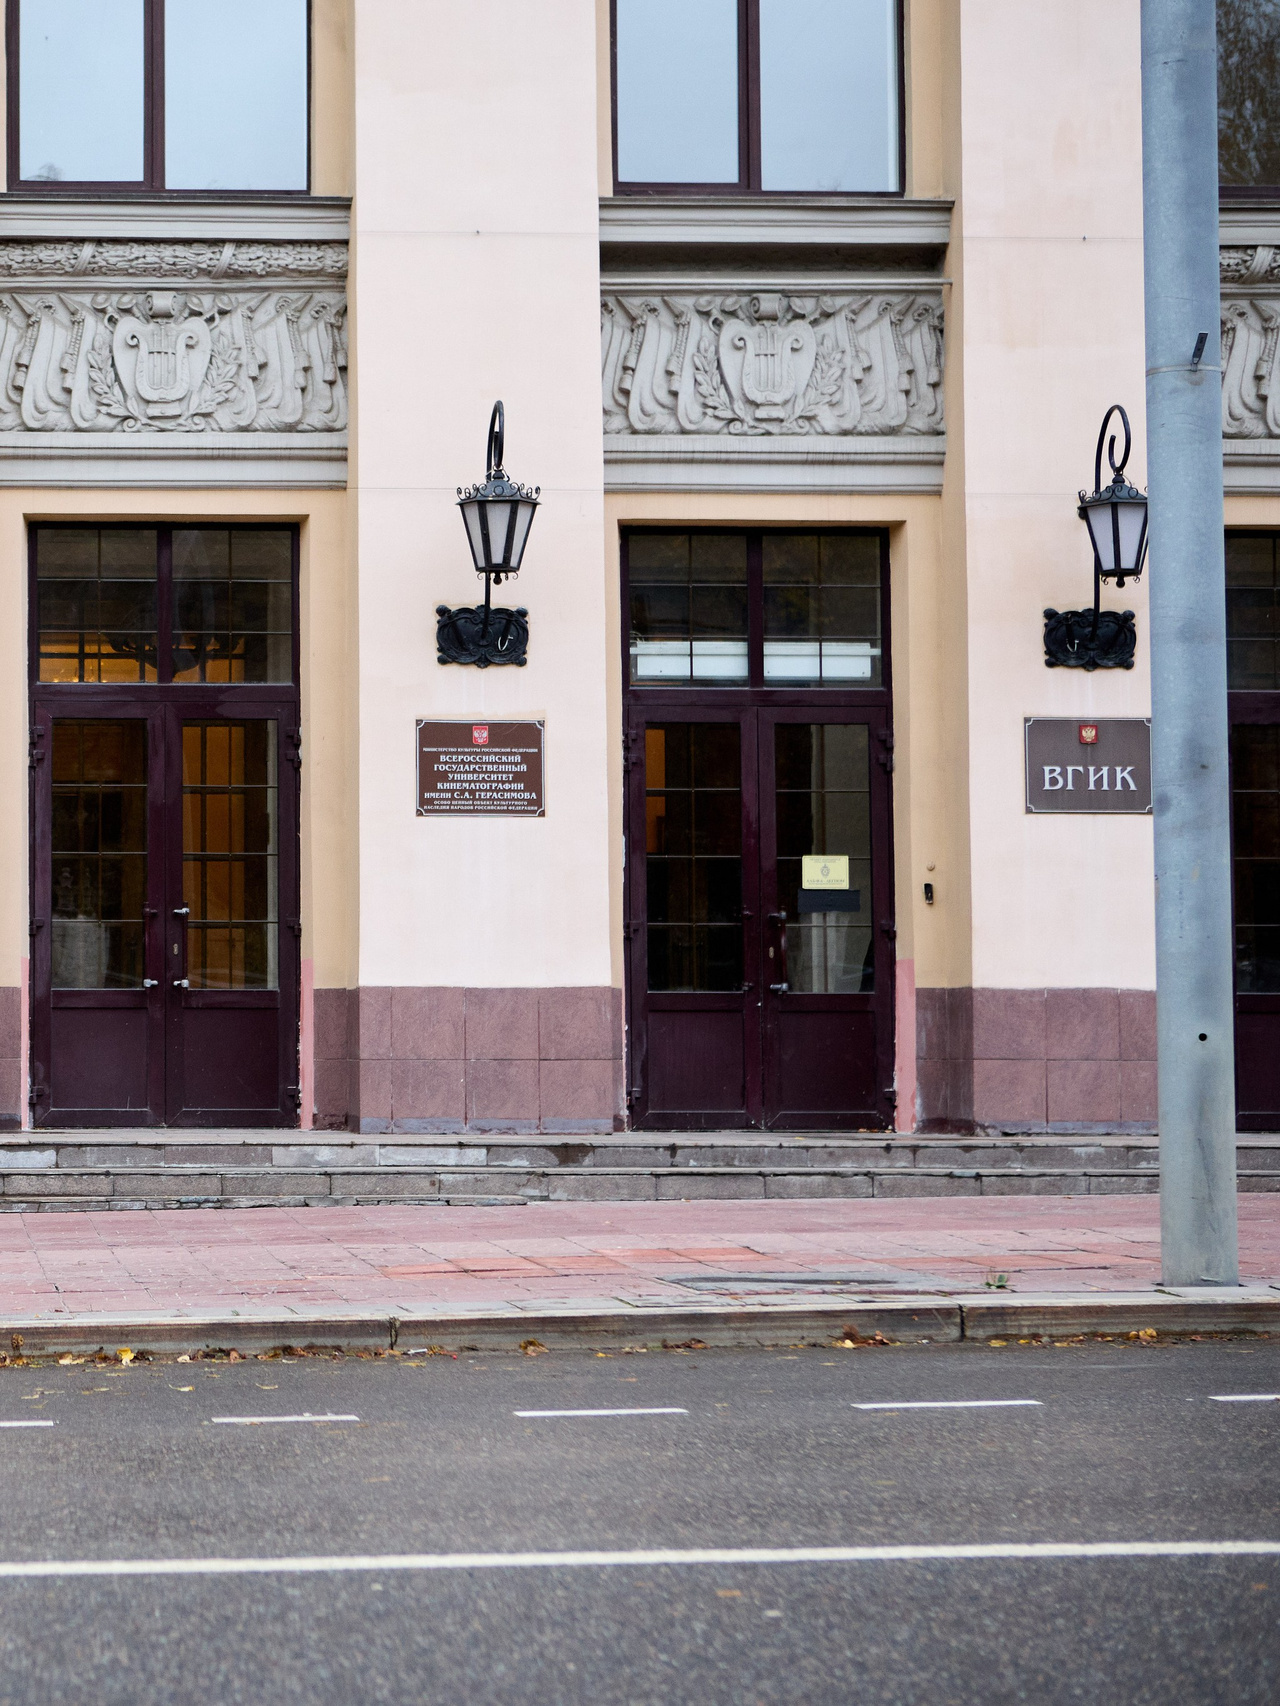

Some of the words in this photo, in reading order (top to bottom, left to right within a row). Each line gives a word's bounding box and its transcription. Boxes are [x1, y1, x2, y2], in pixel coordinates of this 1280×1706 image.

[440, 754, 521, 762] ВСЕРОССИЙСКИЙ
[434, 764, 527, 772] ГОСУДАРСТВЕННЫЙ
[447, 773, 514, 781] УНИВЕРСИТЕТ
[1042, 766, 1137, 791] ВГИК
[437, 782, 524, 790] КИНЕМАТОГРАФИИ
[454, 791, 473, 799] С.А.
